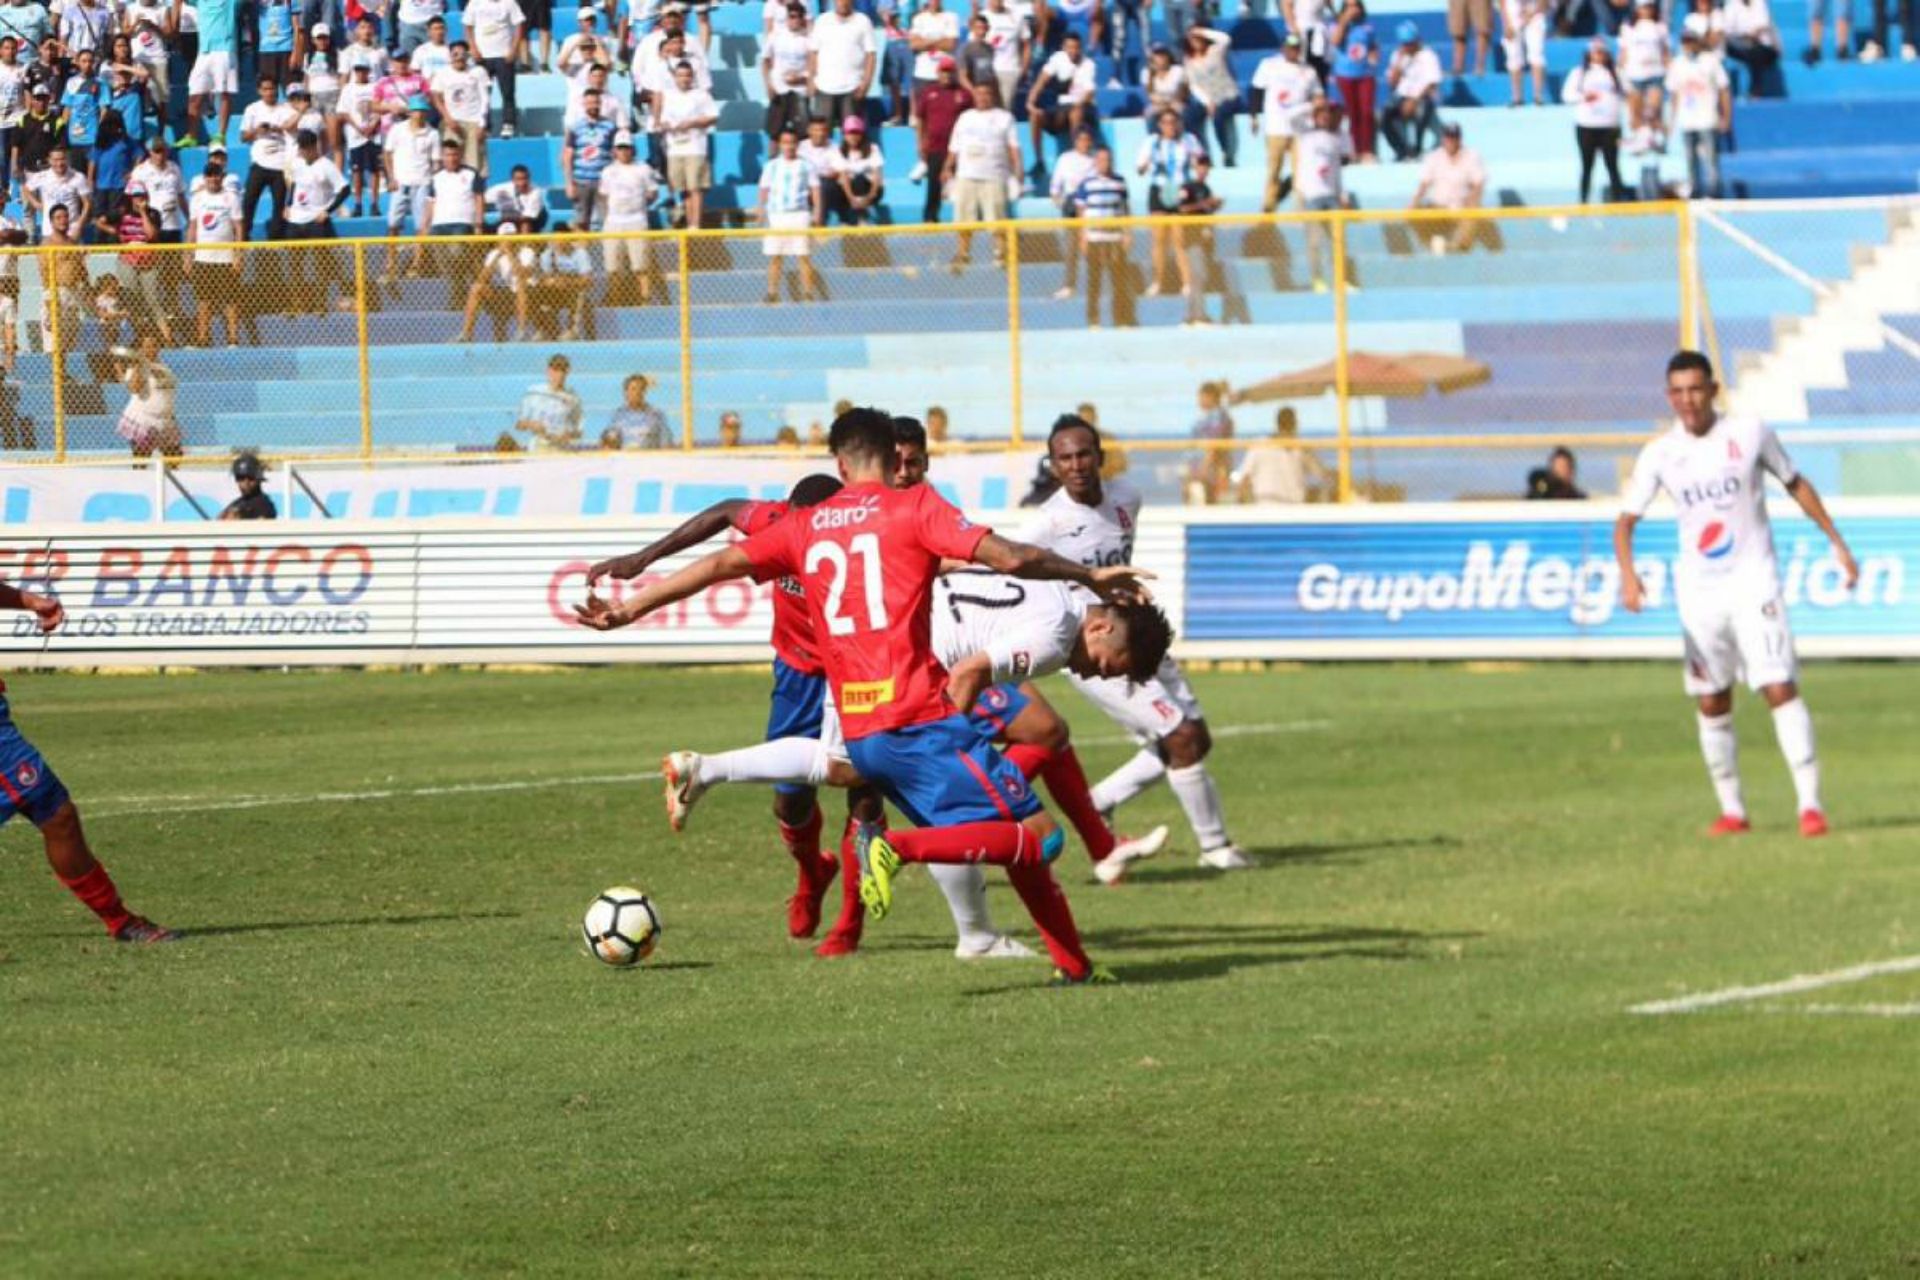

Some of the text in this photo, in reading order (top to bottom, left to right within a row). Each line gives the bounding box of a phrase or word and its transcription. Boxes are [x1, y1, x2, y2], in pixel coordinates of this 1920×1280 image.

[90, 543, 374, 608] BANCO
[805, 532, 889, 637] 21
[61, 612, 120, 638] LOS
[131, 610, 370, 637] TRABAJADORES
